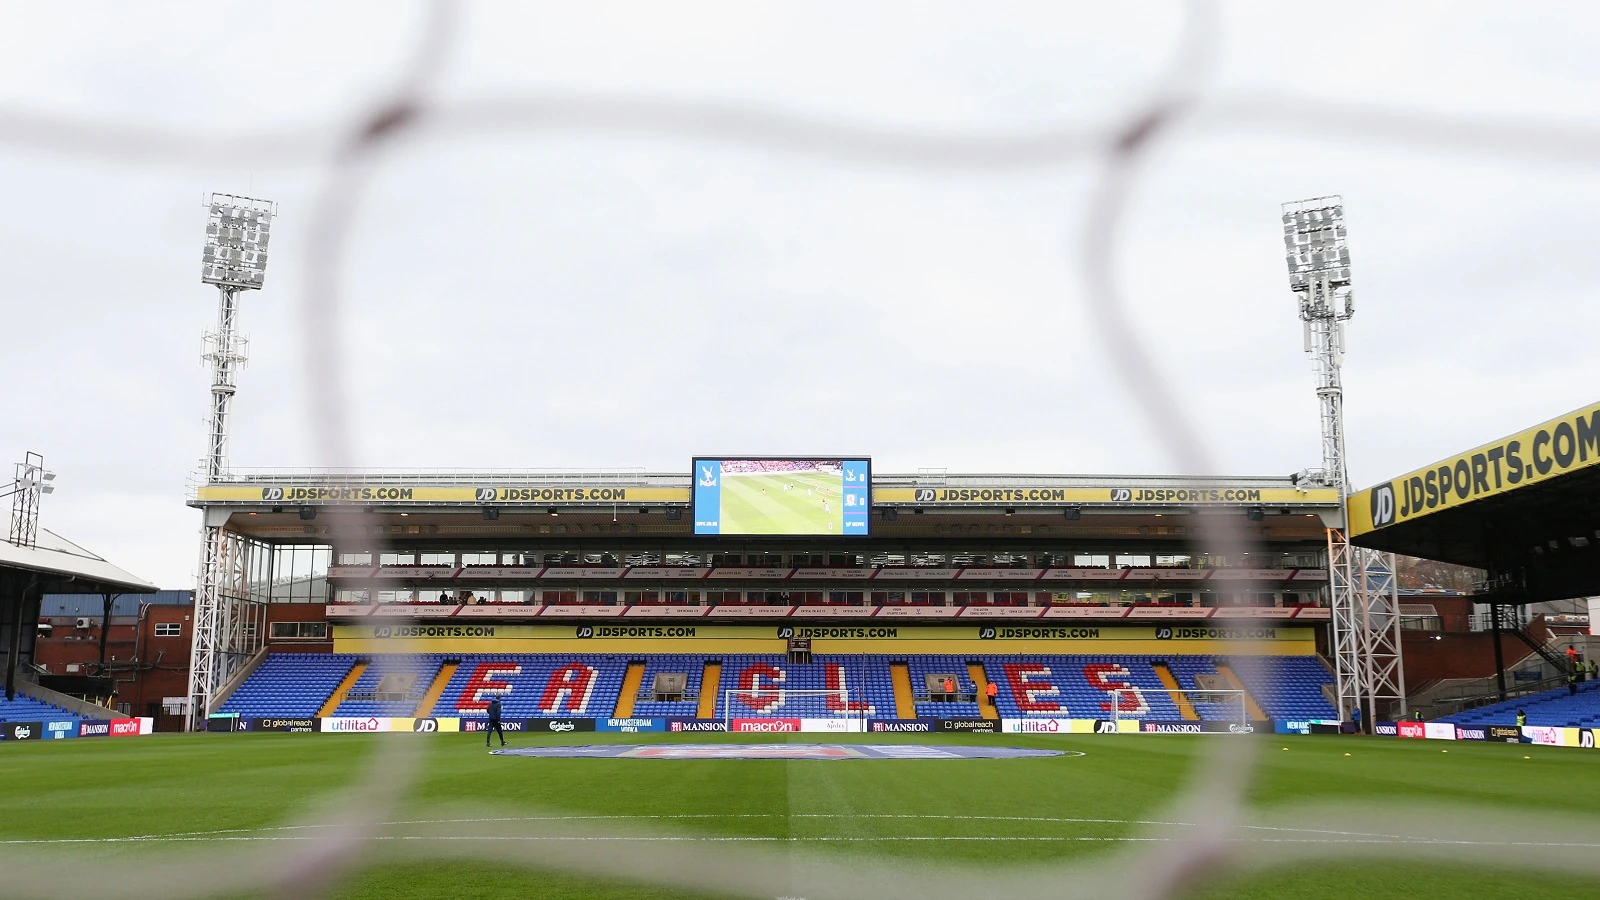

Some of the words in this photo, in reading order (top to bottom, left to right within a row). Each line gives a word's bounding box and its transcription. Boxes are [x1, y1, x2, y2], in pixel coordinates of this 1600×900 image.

[1374, 487, 1392, 526] JD
[1400, 410, 1600, 518] JDSPORTS.COM
[287, 488, 413, 500] JDSPORTS.COM
[500, 488, 626, 501] JDSPORTS.COM
[939, 489, 1065, 501] JDSPORTS.COM
[1135, 489, 1261, 501] JDSPORTS.COM
[394, 627, 495, 637] JDSPORTS.COM
[596, 627, 696, 637] JDSPORTS.COM
[999, 628, 1100, 638] JDSPORTS.COM
[1175, 628, 1276, 639] JDSPORTS.COM
[113, 721, 137, 734] macron
[332, 721, 367, 731] utilita
[477, 722, 521, 731] MSION
[683, 722, 726, 731] MANSION
[741, 720, 793, 732] macron
[884, 723, 929, 732] MANSION
[1013, 721, 1048, 732] utilita
[1157, 724, 1201, 733] MANSION
